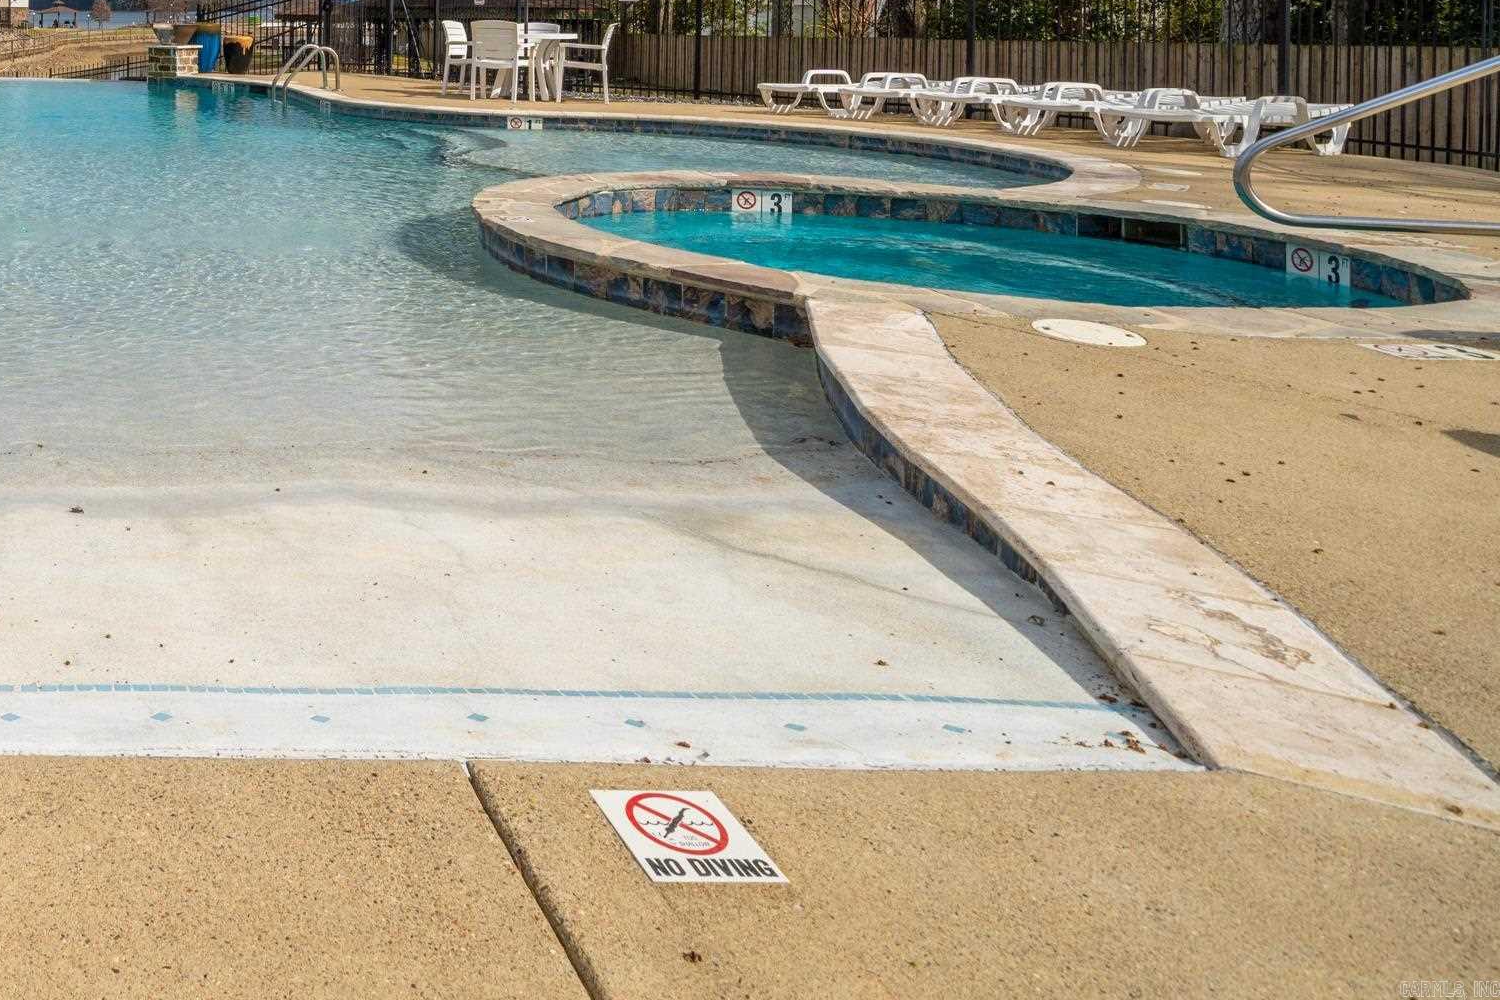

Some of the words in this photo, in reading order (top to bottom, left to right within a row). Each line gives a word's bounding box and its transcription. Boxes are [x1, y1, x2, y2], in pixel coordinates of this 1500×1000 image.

[526, 119, 532, 130] 1
[770, 193, 783, 215] 3
[1328, 255, 1340, 284] 3
[645, 857, 686, 877] NO
[687, 858, 779, 878] DIVING
